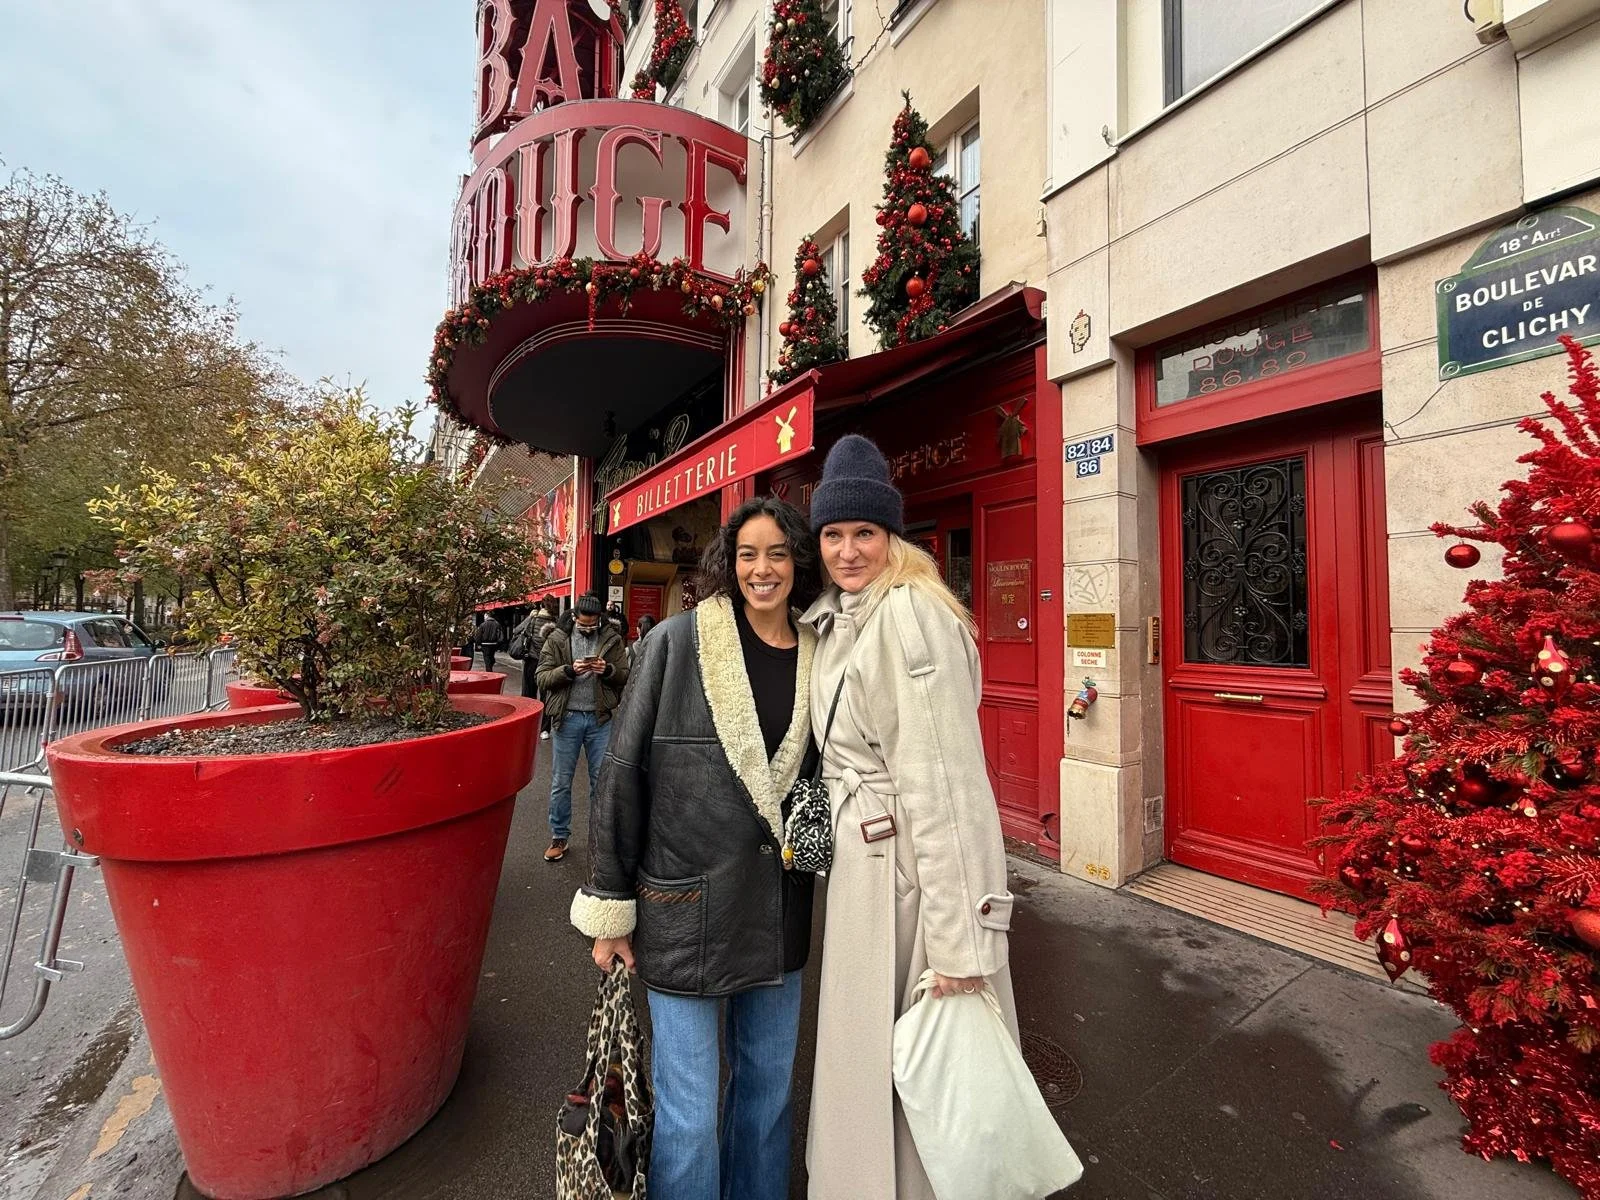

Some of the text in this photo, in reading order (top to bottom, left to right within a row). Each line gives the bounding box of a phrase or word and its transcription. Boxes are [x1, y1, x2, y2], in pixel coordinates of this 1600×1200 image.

[1523, 296, 1544, 312] DE
[1482, 303, 1591, 349] CLICHY
[1067, 437, 1111, 459] 82 84
[1079, 459, 1098, 475] 86
[636, 443, 738, 517] BILLETTERIE
[1076, 651, 1102, 659] COLONNE
